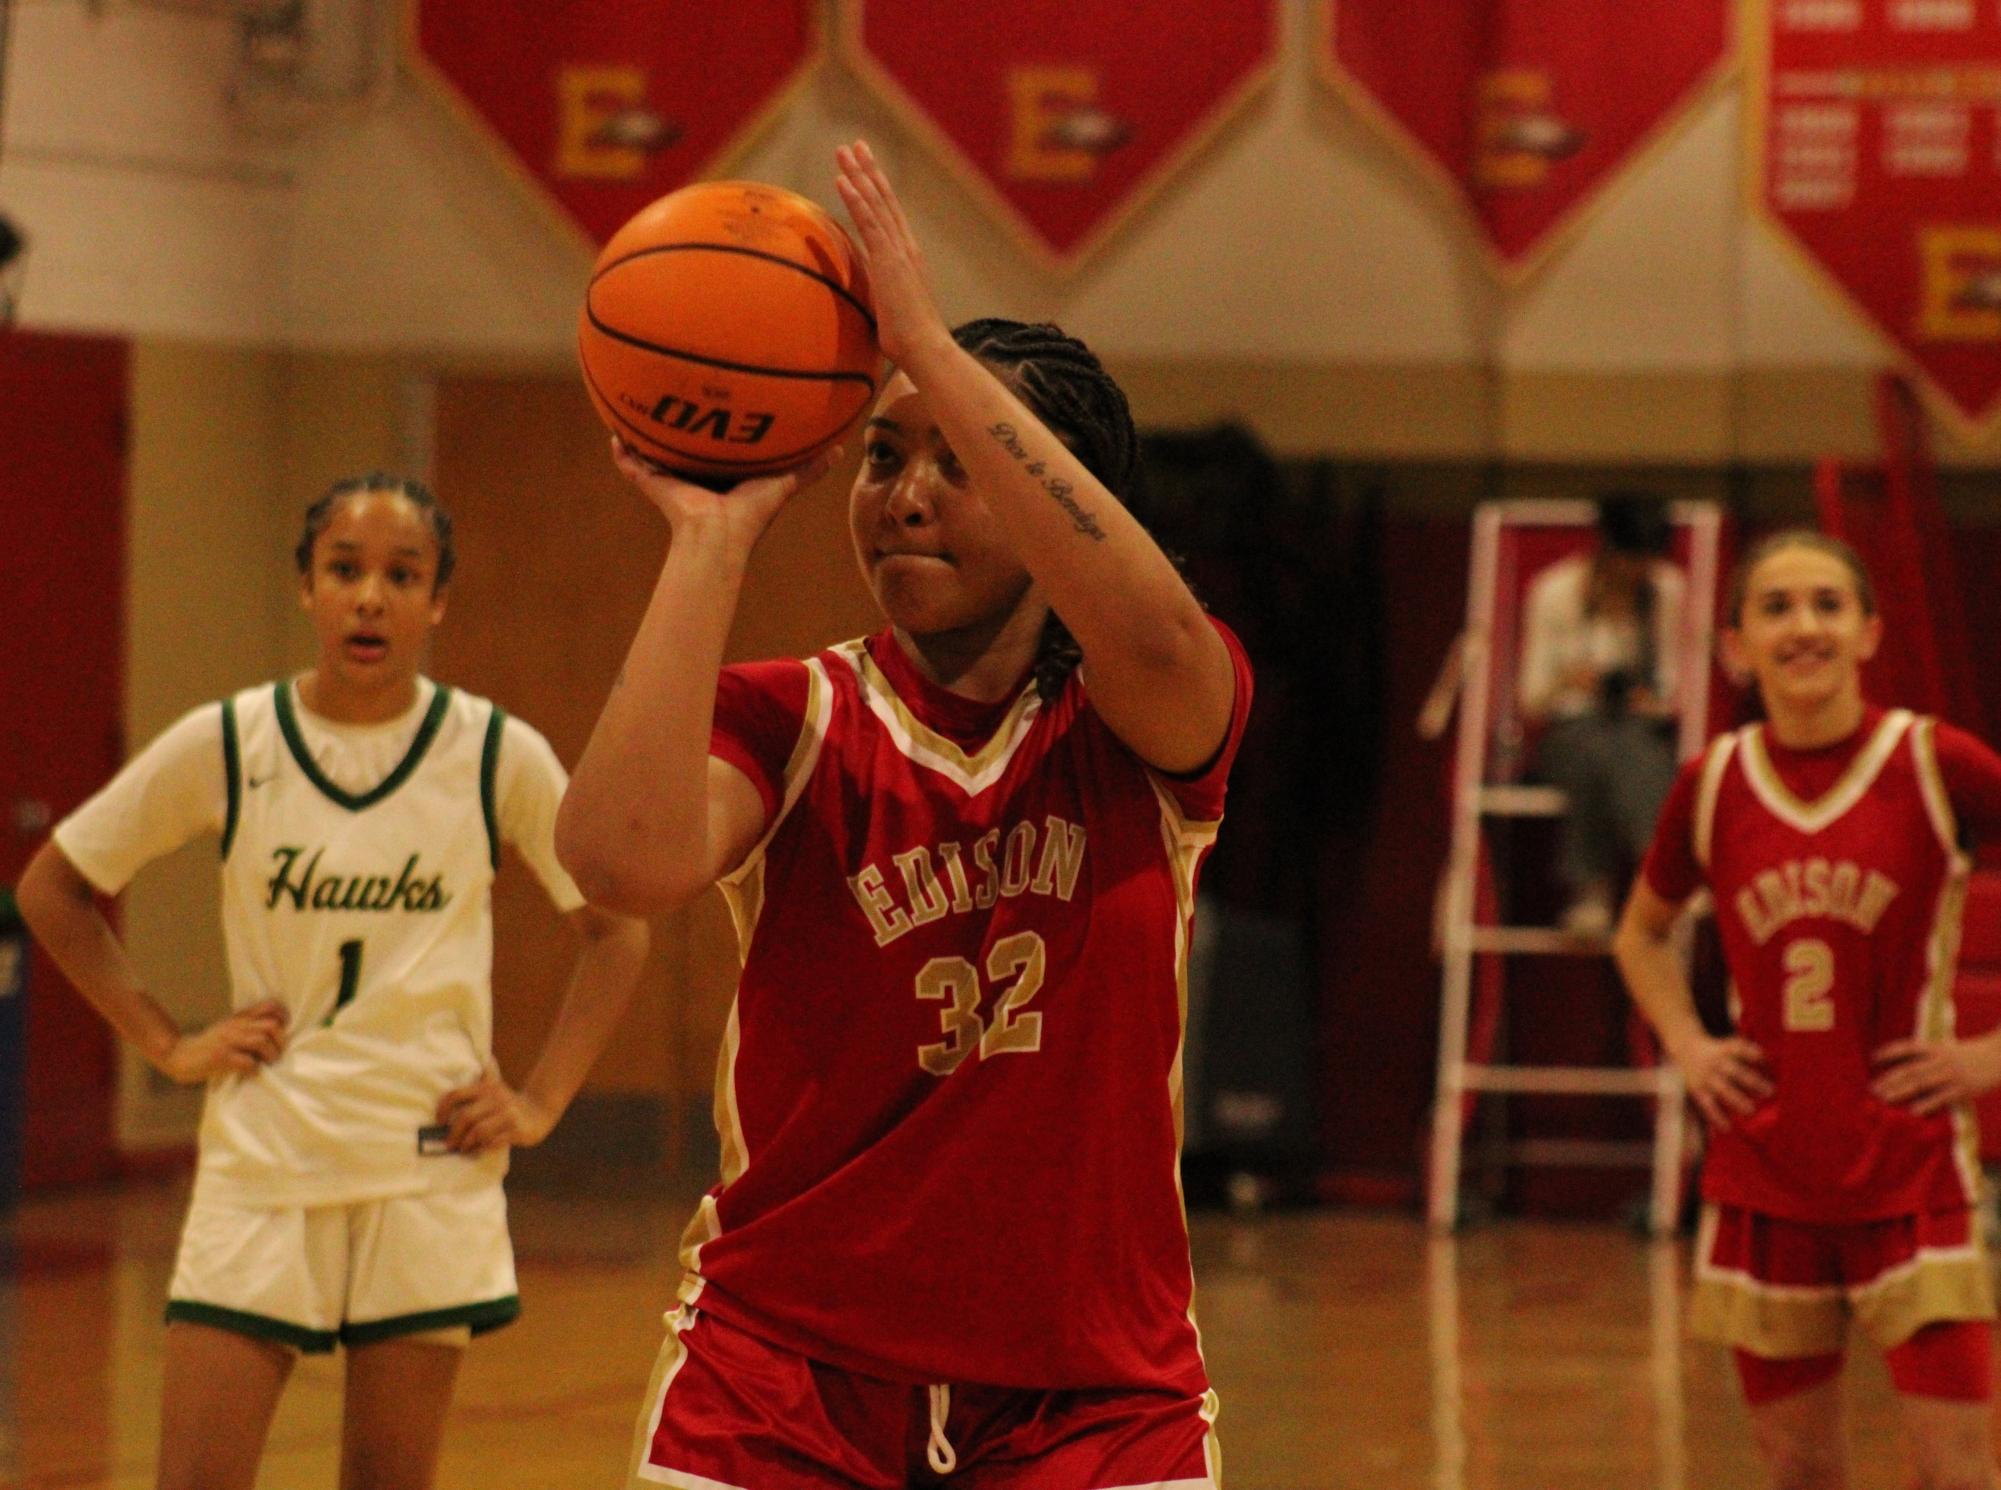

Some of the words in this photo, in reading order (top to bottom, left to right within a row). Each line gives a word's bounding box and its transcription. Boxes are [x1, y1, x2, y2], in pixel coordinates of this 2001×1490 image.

[649, 396, 775, 443] EVO
[265, 846, 453, 912] Hawks
[846, 815, 1087, 948] EDISON
[321, 939, 363, 1028] 1
[915, 930, 1046, 1076] 32
[1781, 936, 1836, 1032] 2
